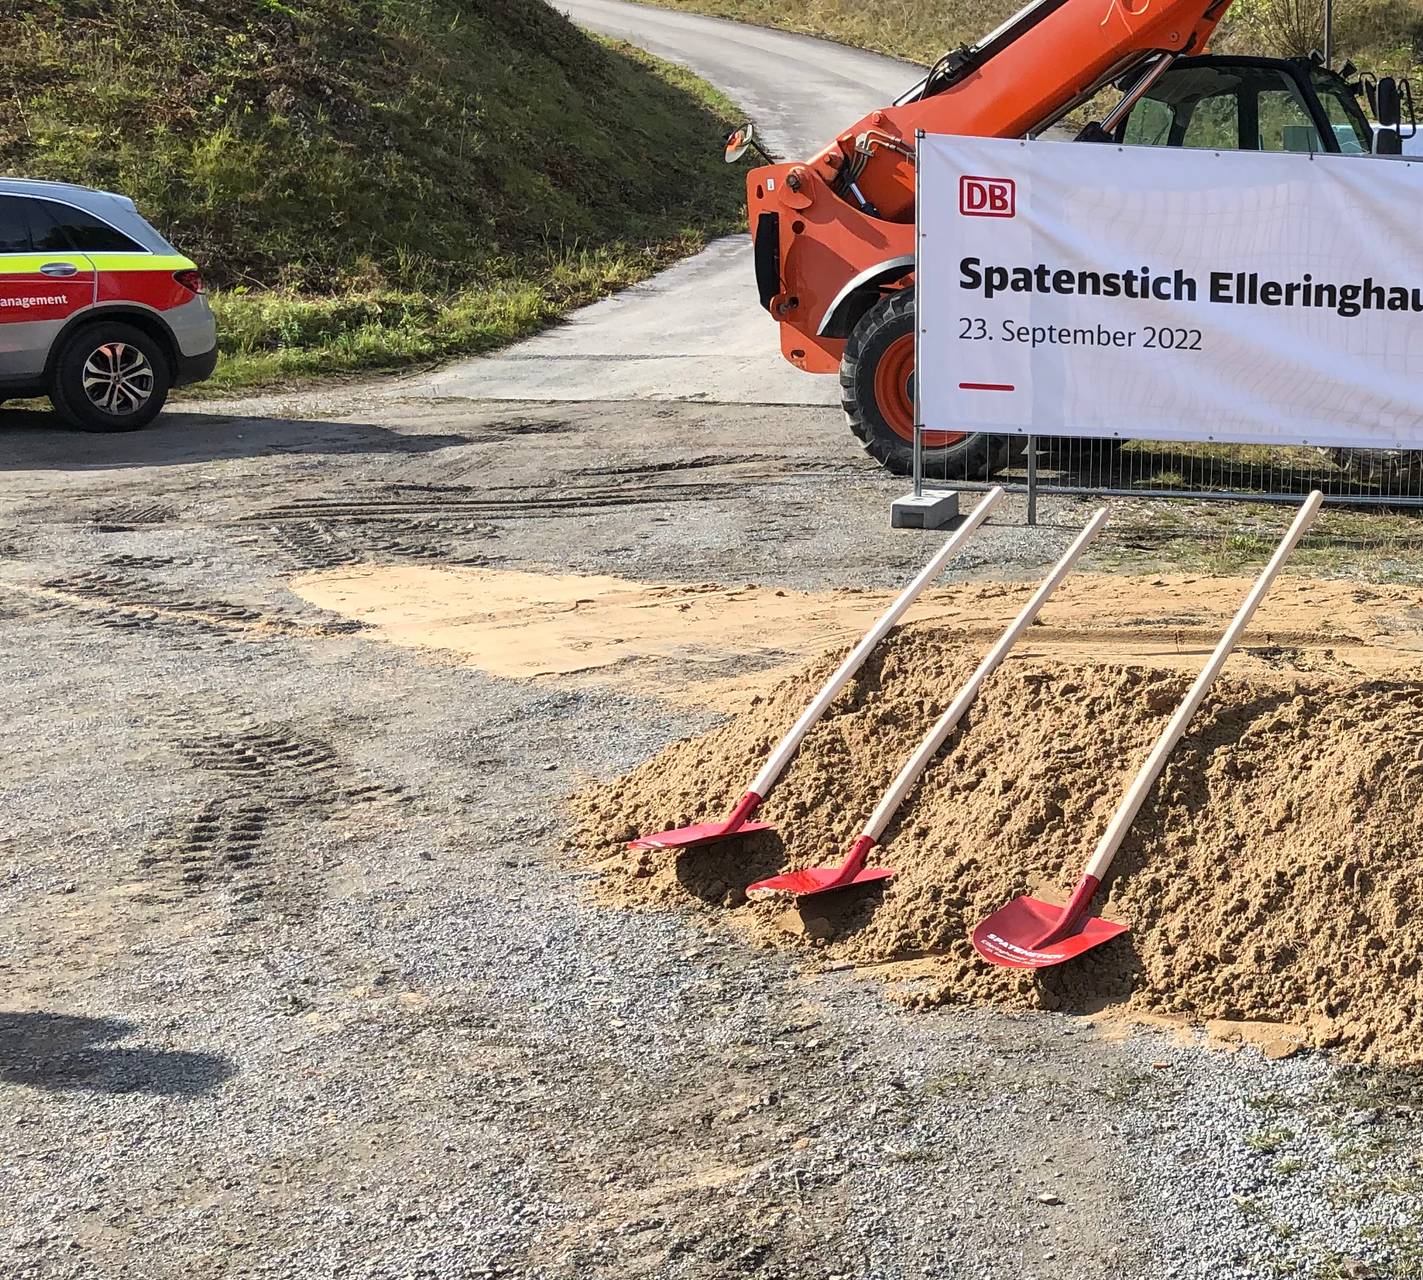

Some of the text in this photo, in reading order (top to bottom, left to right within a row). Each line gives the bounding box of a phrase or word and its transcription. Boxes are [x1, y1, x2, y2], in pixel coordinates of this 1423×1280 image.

[965, 181, 1010, 212] DB
[958, 256, 1197, 301] Spatenstich
[958, 317, 1203, 350] 23. September 2022
